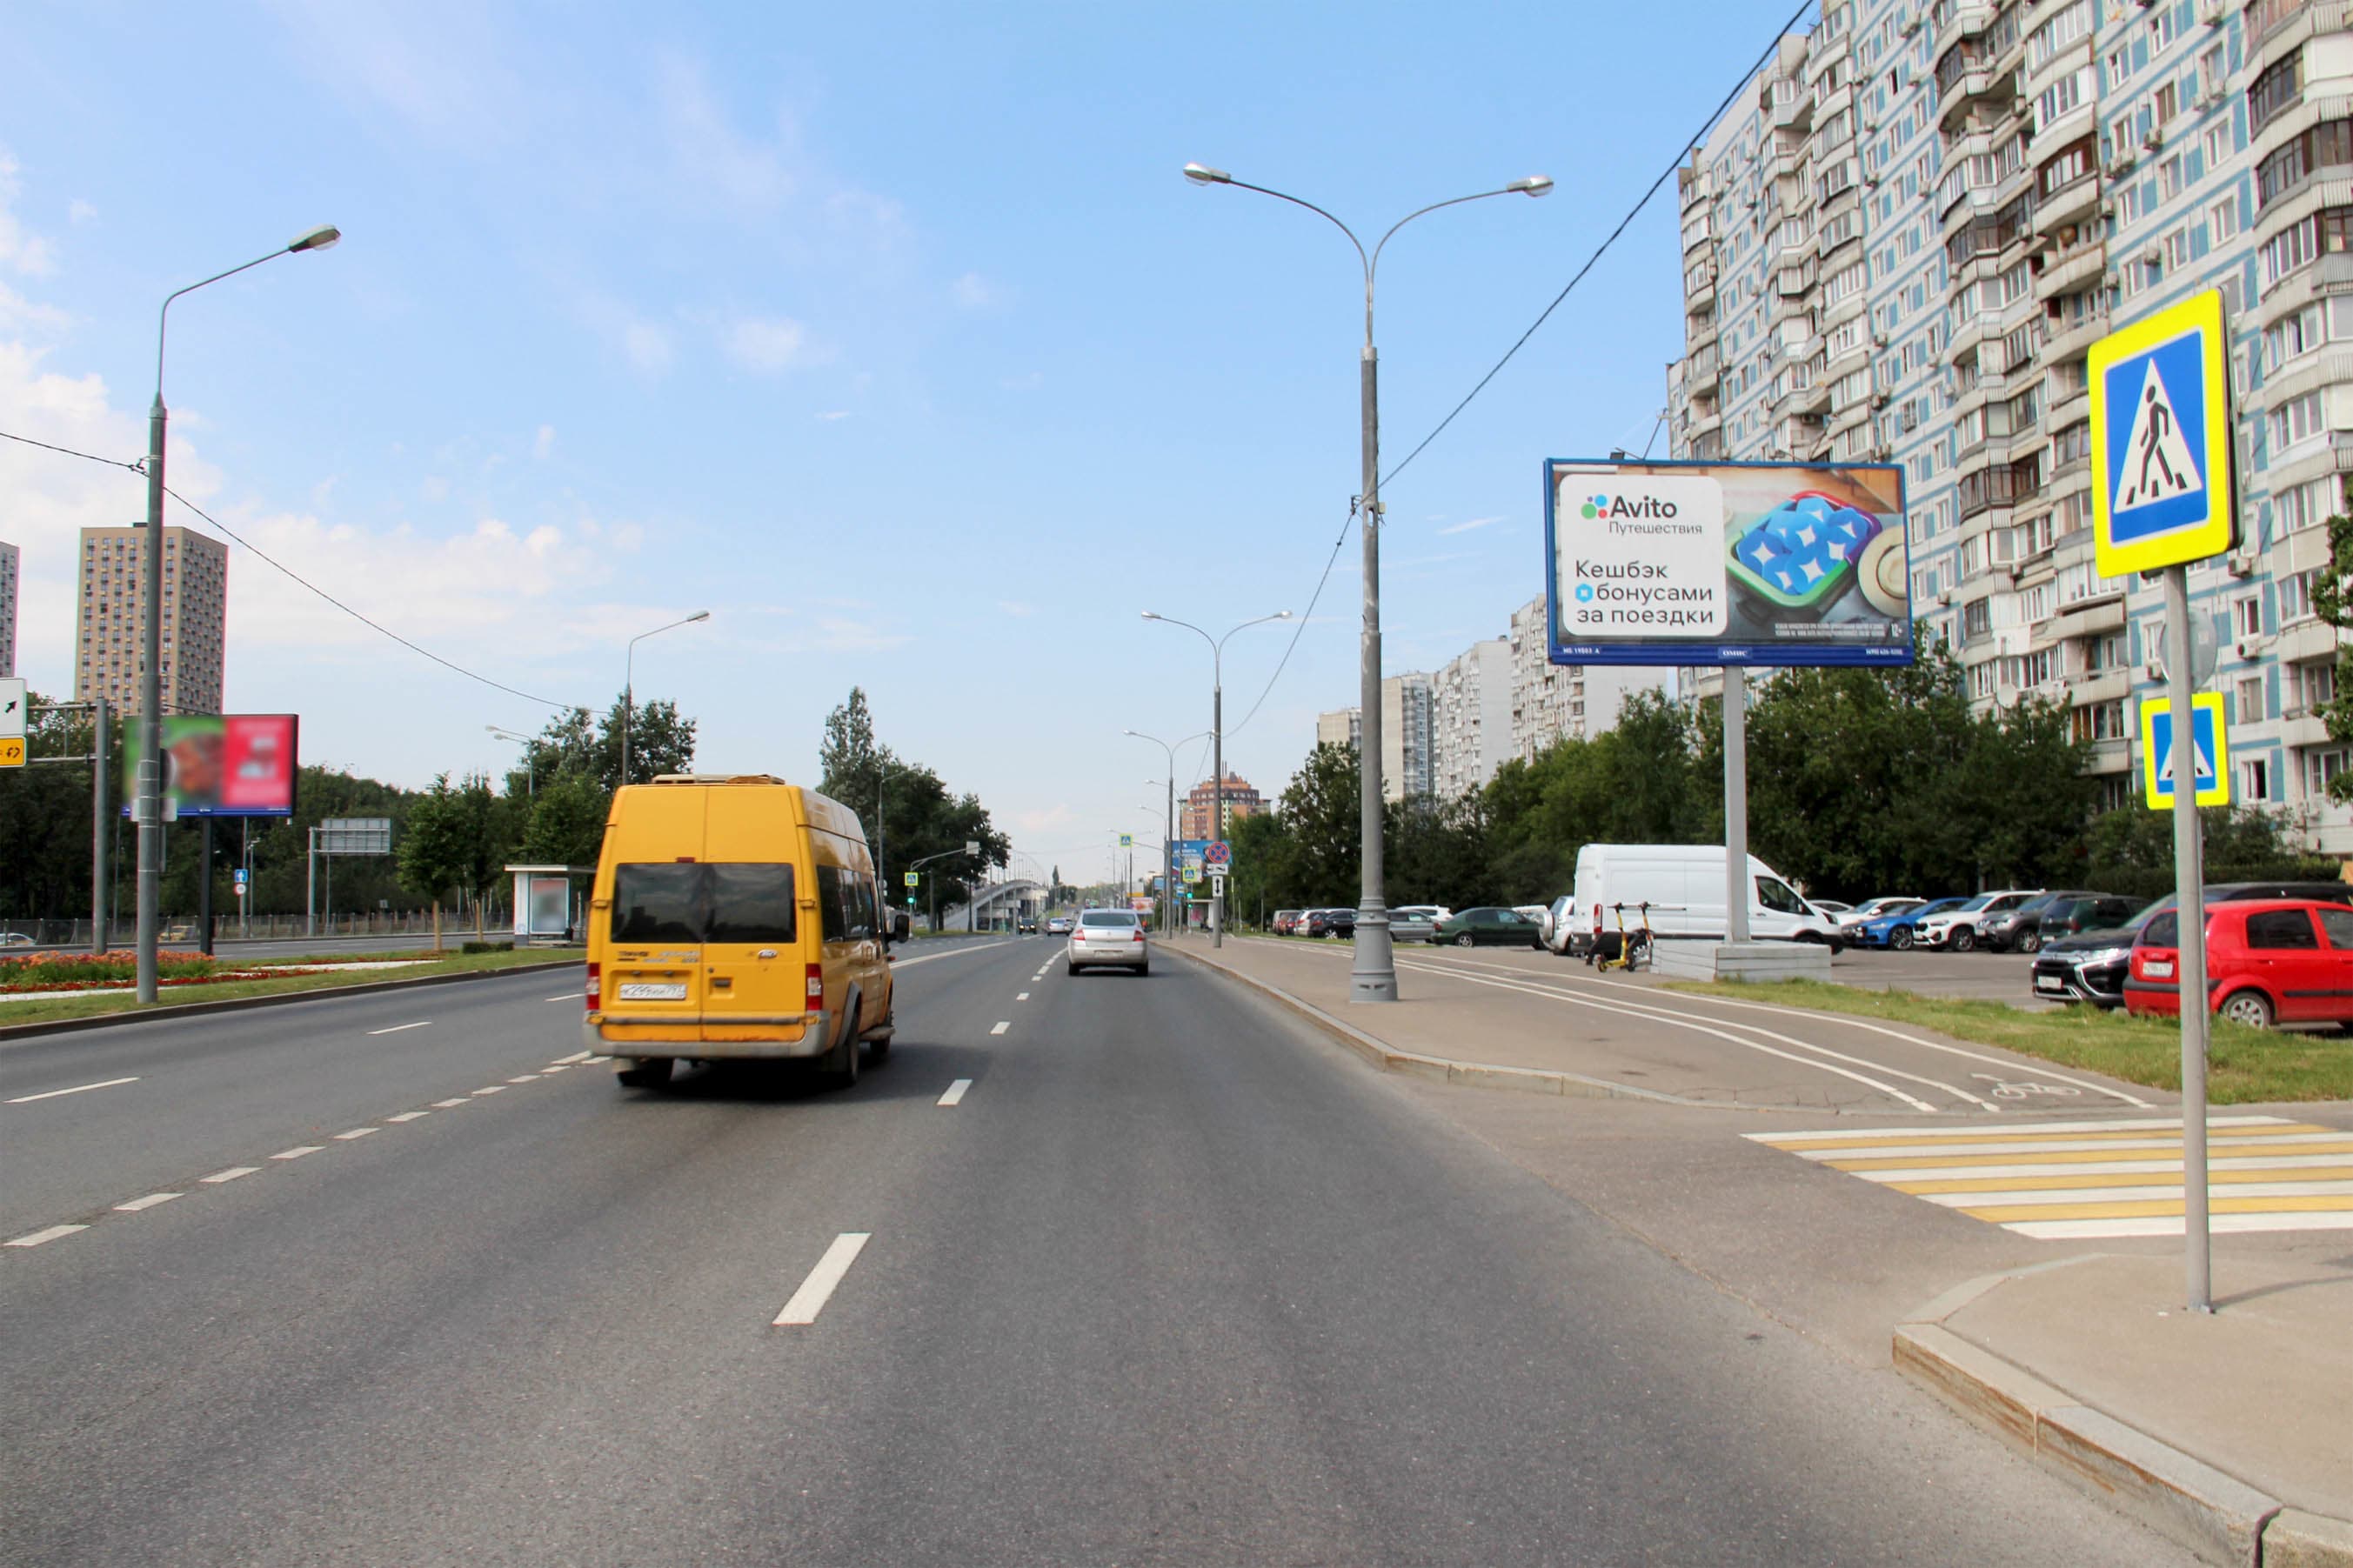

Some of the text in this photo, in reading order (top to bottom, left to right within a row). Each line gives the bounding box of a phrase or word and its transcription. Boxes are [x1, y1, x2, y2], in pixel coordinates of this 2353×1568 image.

[1609, 495, 1678, 518] Avito
[1609, 521, 1702, 536] Путешествия
[1575, 559, 1668, 578] Кешбэк
[1596, 583, 1713, 606] бонусами
[1577, 610, 1714, 626] за поездки
